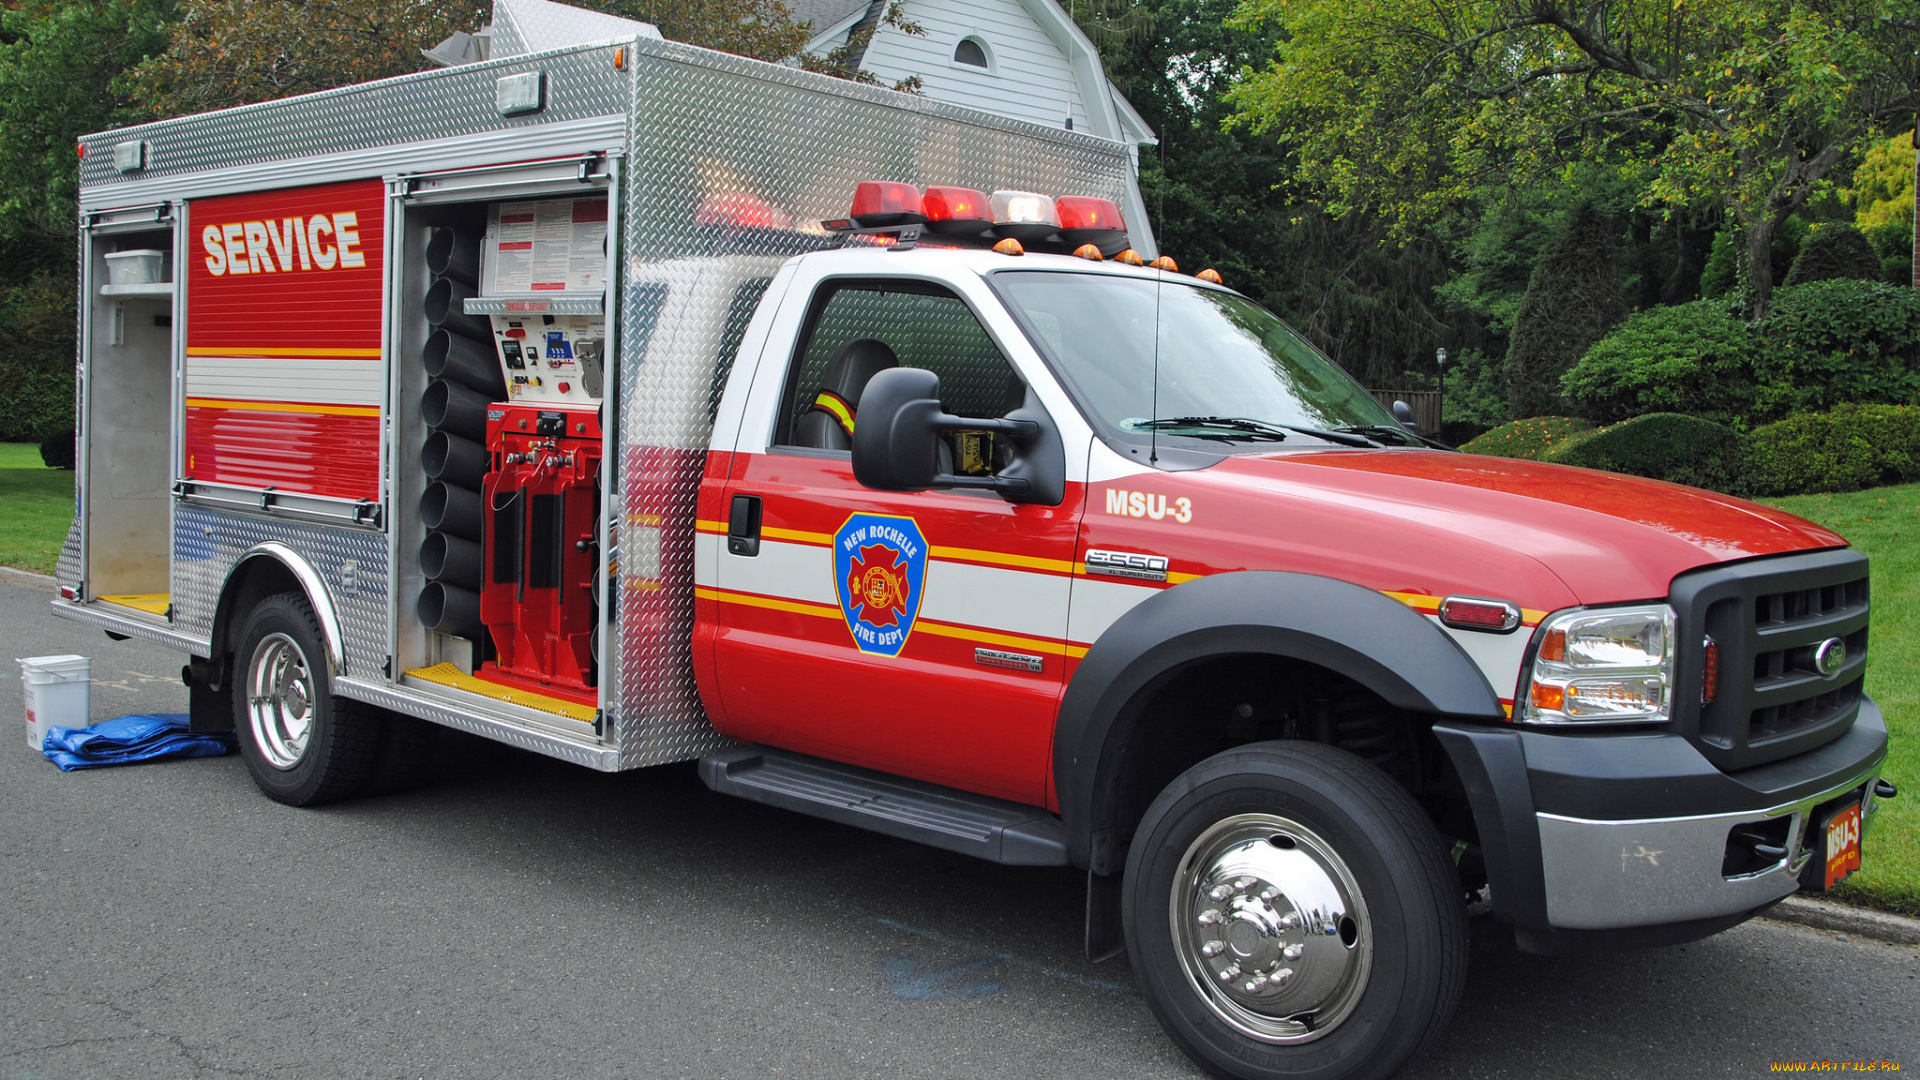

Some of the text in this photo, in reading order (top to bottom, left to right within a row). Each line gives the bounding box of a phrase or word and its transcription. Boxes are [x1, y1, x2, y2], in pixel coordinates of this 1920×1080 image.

[202, 211, 366, 277] SERVICE
[190, 454, 195, 469] 6
[1106, 488, 1192, 523] MSU-3
[843, 525, 917, 559] NEW ROCHELLE
[1119, 570, 1143, 578] SUPER
[853, 622, 904, 646] FIRE DEPT
[977, 656, 1001, 665] TURBO
[1001, 660, 1029, 670] DIESEL
[1827, 816, 1859, 862] MSU-3
